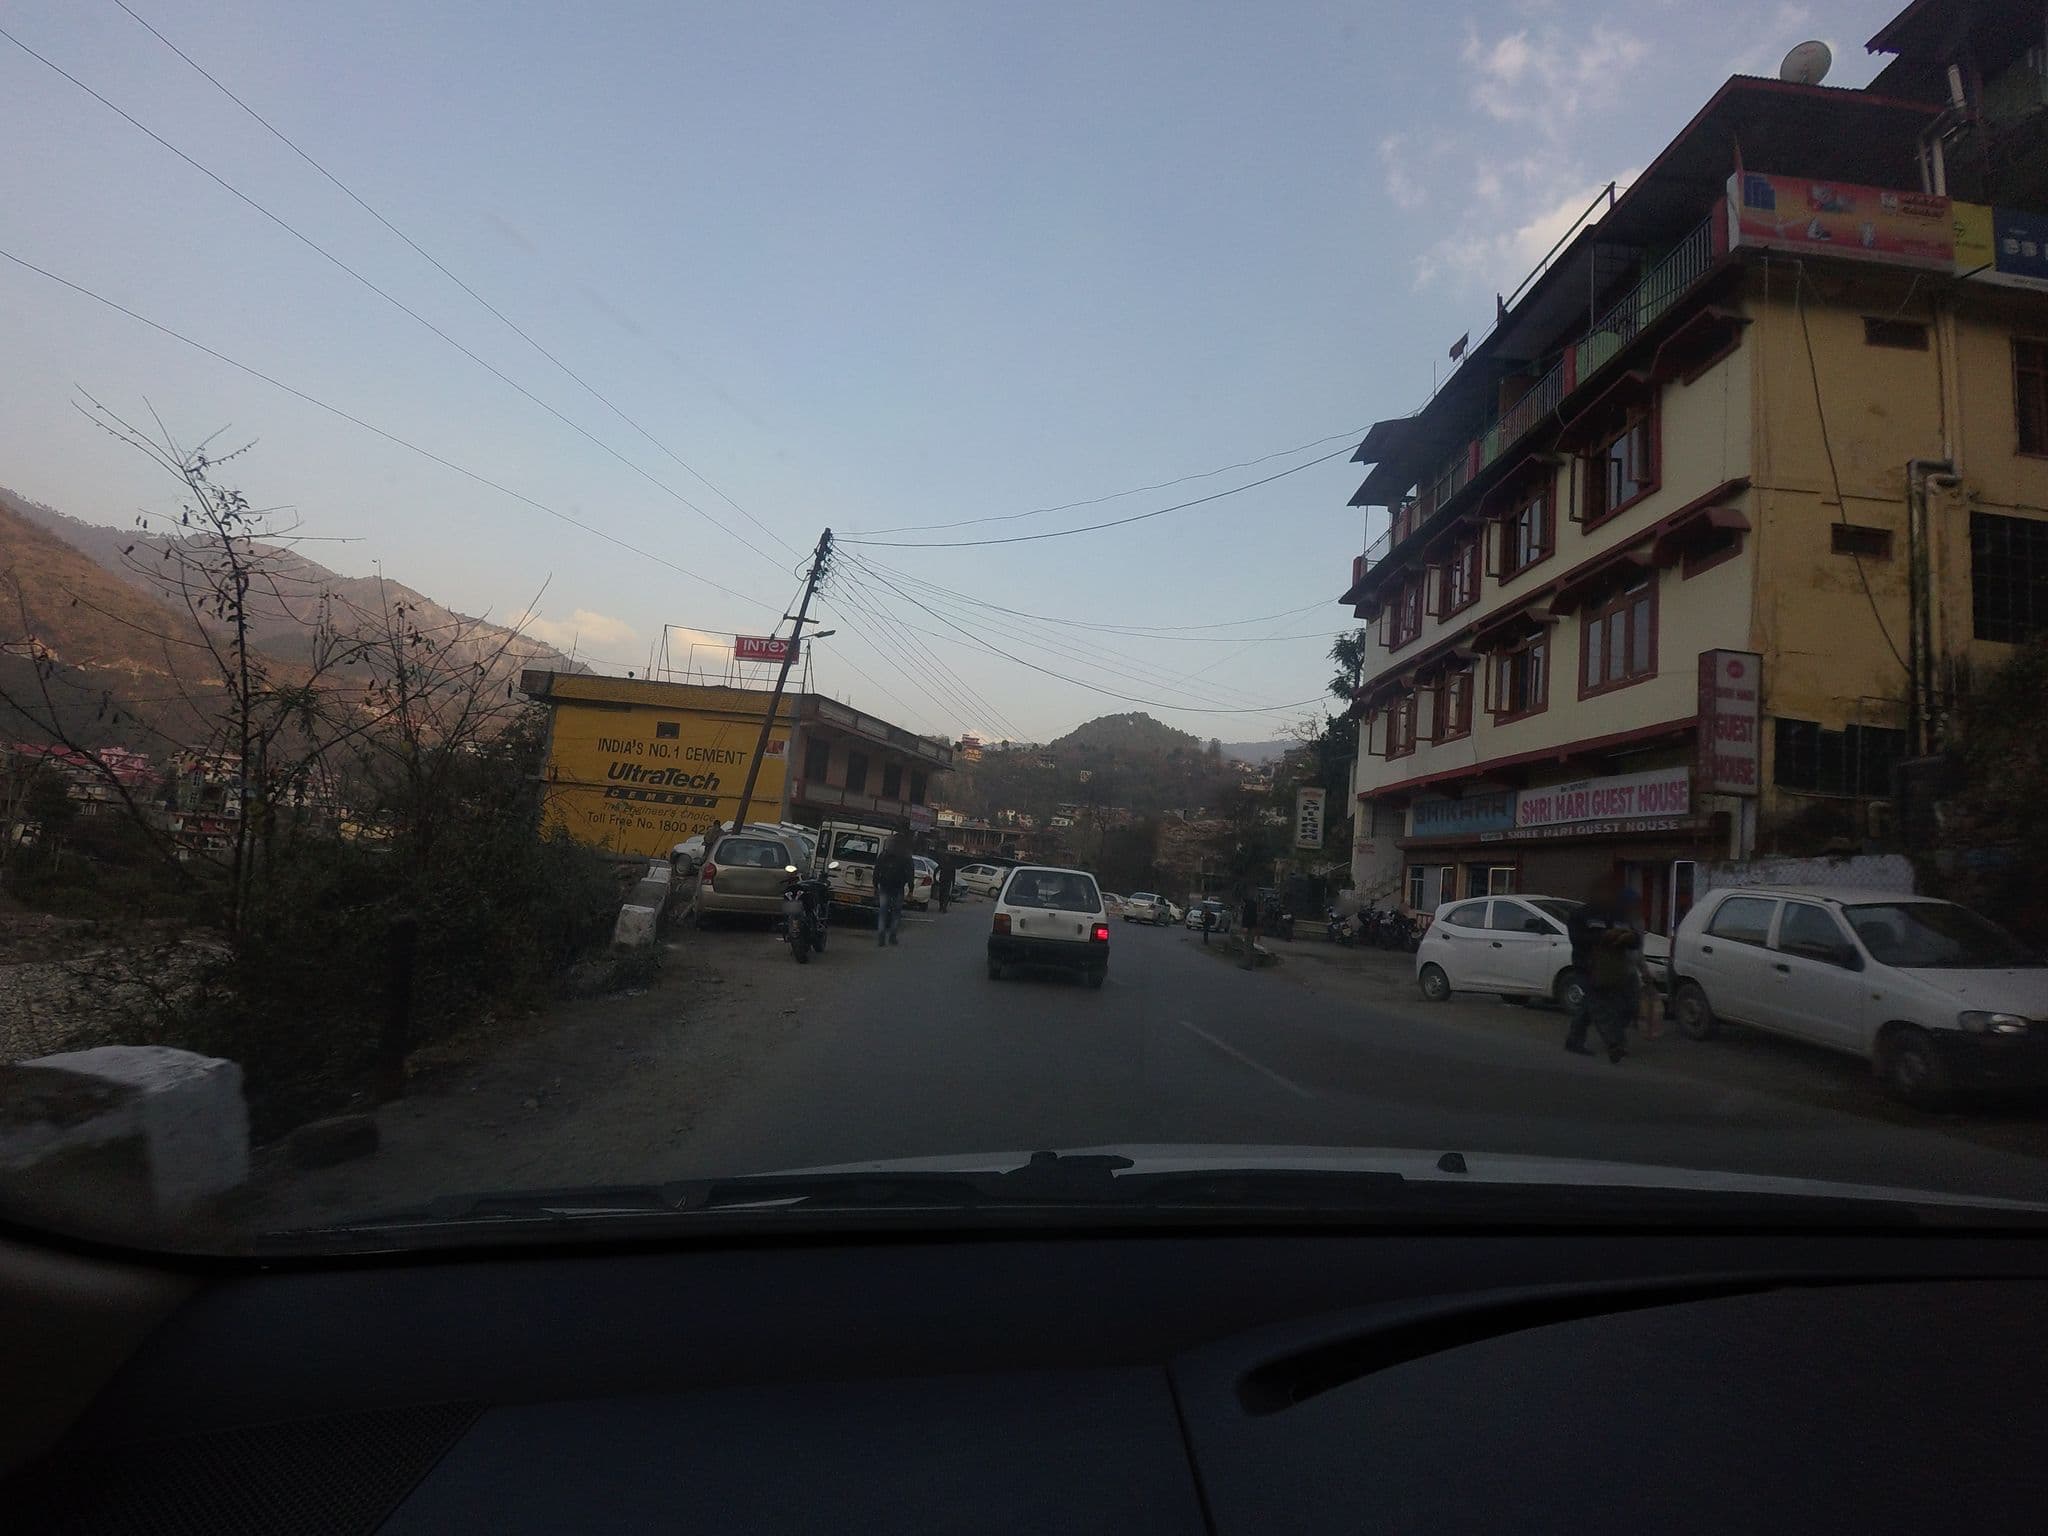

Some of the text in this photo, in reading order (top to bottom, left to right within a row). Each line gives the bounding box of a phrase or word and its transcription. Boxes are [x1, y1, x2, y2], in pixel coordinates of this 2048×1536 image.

[598, 737, 643, 755] INDIA'S
[686, 747, 747, 765] CEMENT
[607, 761, 721, 791] UltraTech
[610, 789, 714, 807] CEMENT
[1521, 779, 1688, 824] SHRI HARI GUEST HOUSE
[588, 811, 605, 823] Toll
[609, 815, 632, 827] Free
[637, 818, 655, 830] No.
[659, 820, 687, 833] 1800
[1576, 822, 1621, 834] GUEST
[1626, 818, 1680, 832] HOUSE
